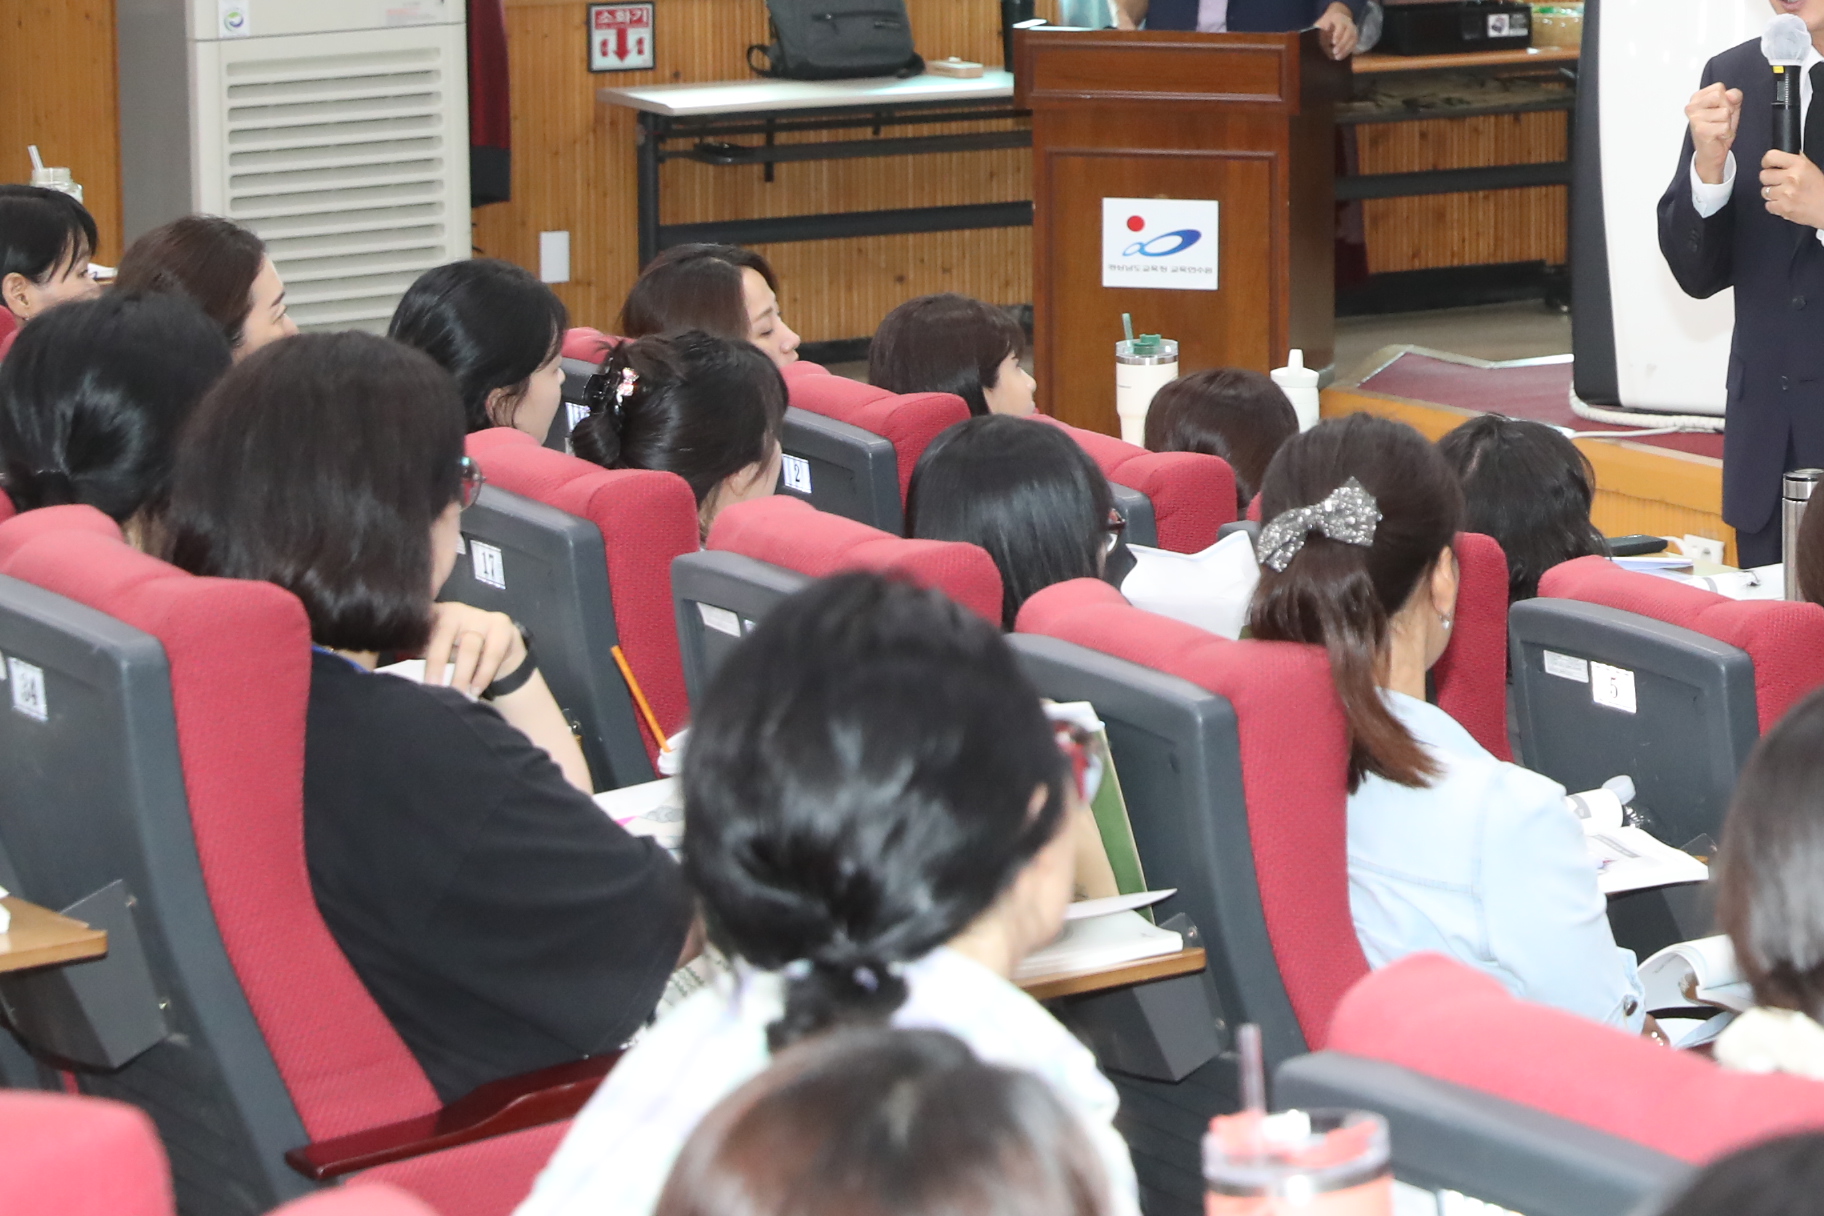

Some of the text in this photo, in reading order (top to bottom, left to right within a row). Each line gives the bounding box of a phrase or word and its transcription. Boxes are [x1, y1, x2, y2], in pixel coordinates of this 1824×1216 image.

[598, 8, 648, 25] 소화기
[793, 463, 802, 483] 2
[481, 551, 496, 577] 17
[1609, 676, 1620, 699] 5
